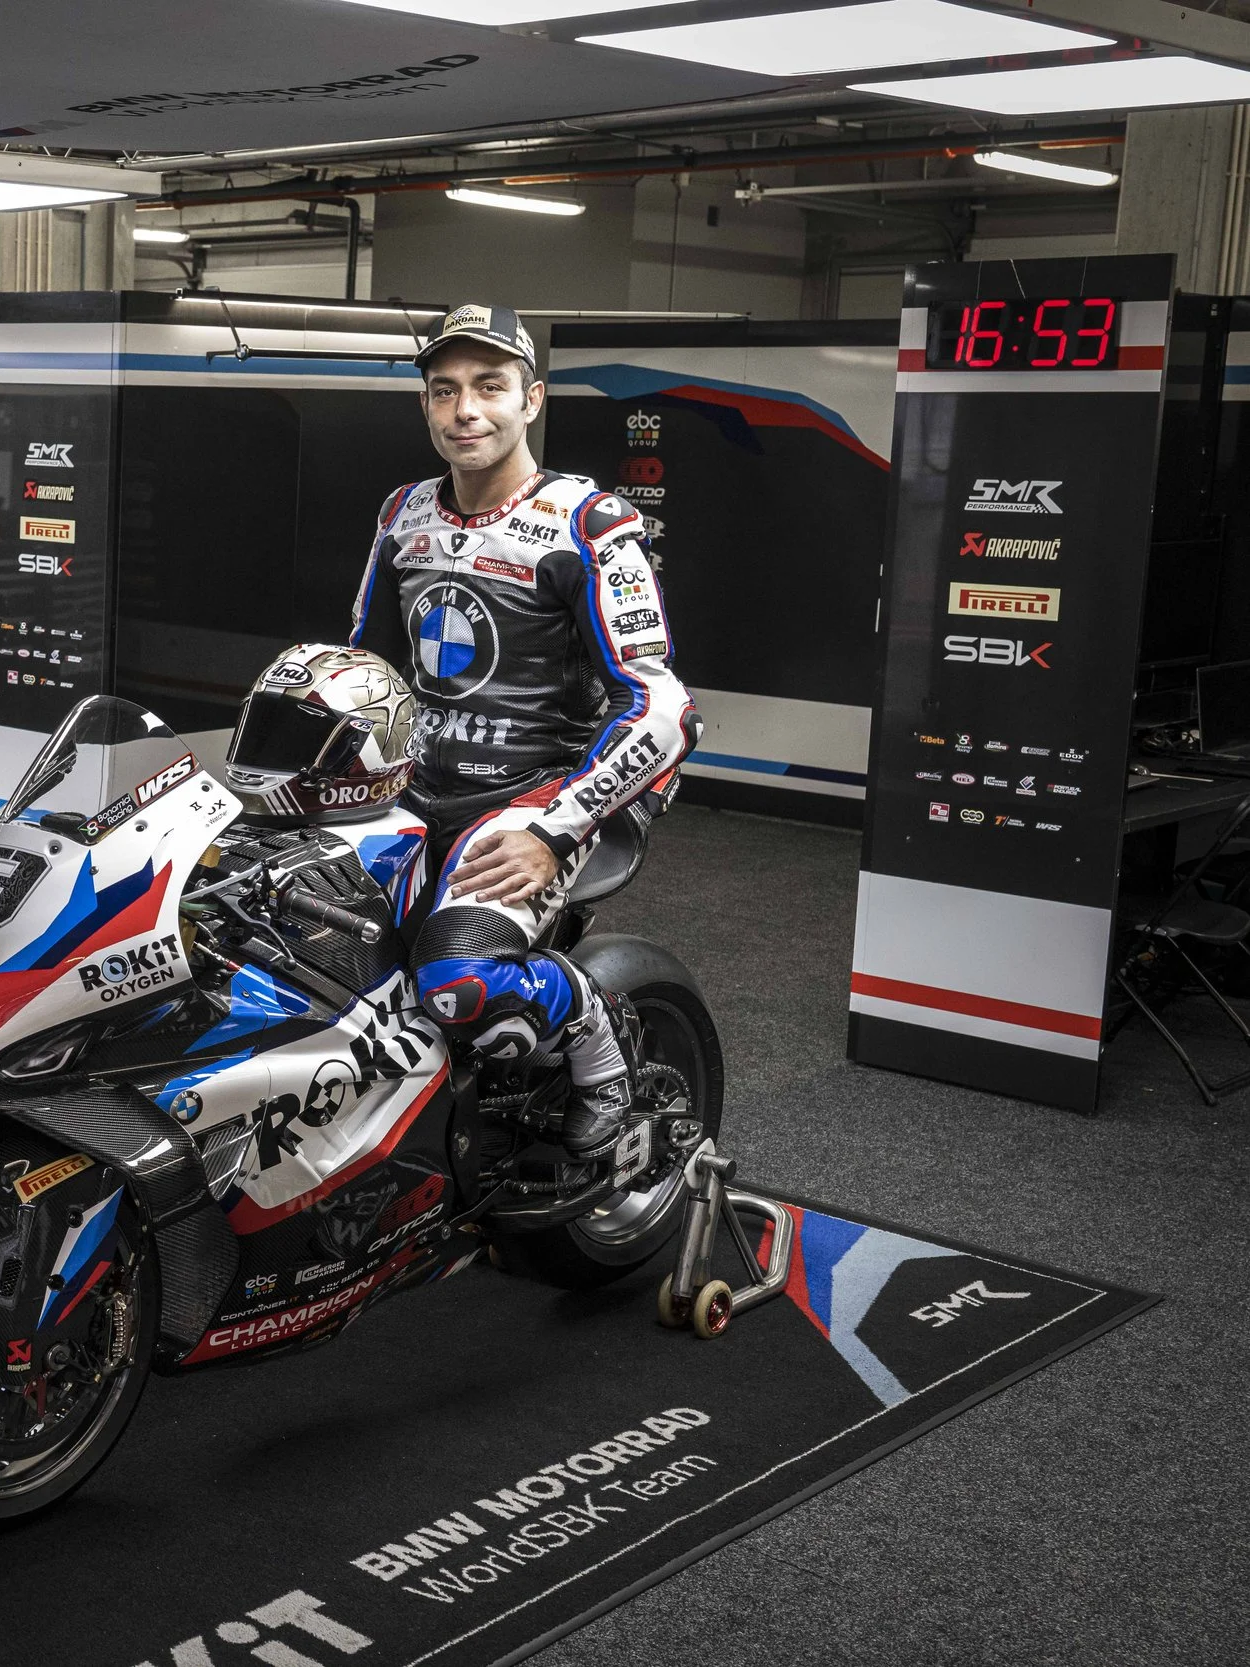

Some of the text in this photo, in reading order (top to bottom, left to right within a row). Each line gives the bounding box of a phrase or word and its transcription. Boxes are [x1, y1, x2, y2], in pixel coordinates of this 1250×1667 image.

[444, 316, 487, 331] BARDAHL
[955, 298, 1116, 367] 16:53
[627, 410, 661, 429] ebc
[628, 439, 658, 447] group
[614, 486, 665, 498] OUTDO
[969, 479, 1063, 514] SMR
[967, 503, 1033, 512] PERFORMANCE
[25, 521, 70, 539] PIRELLI
[401, 512, 432, 531] ROKiT
[508, 517, 560, 543] ROKiT
[518, 535, 540, 546] OFF
[18, 553, 73, 577] SBK
[401, 556, 434, 564] OUTDO
[476, 557, 527, 576] CHAMPION
[607, 566, 646, 588] ebc
[416, 588, 485, 625] BMW
[616, 593, 650, 606] group
[959, 589, 1050, 614] PIRELLI
[619, 609, 655, 626] ROKiT
[633, 622, 648, 630] OFF
[944, 635, 1053, 669] SBK
[272, 664, 308, 680] Arai
[420, 707, 512, 746] OKiT
[927, 736, 945, 745] Beta
[1059, 752, 1084, 760] EDOX
[138, 754, 192, 804] WRS
[458, 763, 509, 776] SBK
[574, 732, 661, 813] ROKiT
[590, 796, 613, 820] BMW
[614, 752, 668, 799] MOTORRAD
[97, 794, 132, 824] Bonamici
[107, 804, 134, 826] Racing
[86, 820, 101, 836] 8
[78, 934, 181, 992] ROKiT
[100, 966, 175, 1002] OXYGEN
[251, 984, 436, 1172] ROKiT
[173, 1092, 200, 1107] BMW
[595, 1077, 631, 1112] 9
[613, 1120, 651, 1189] 9
[18, 1156, 88, 1198] PIRELLI
[367, 1203, 444, 1253] OUTDO
[245, 1273, 278, 1290] ebc
[339, 1268, 364, 1285] BEER
[245, 1288, 274, 1299] group
[909, 1280, 1031, 1328] SMR
[209, 1275, 375, 1347] CHAMPION
[231, 1300, 349, 1350] LUBRICANTS
[350, 1406, 711, 1582] BMW MOTORRAD
[402, 1454, 718, 1604] WorldSBK Team
